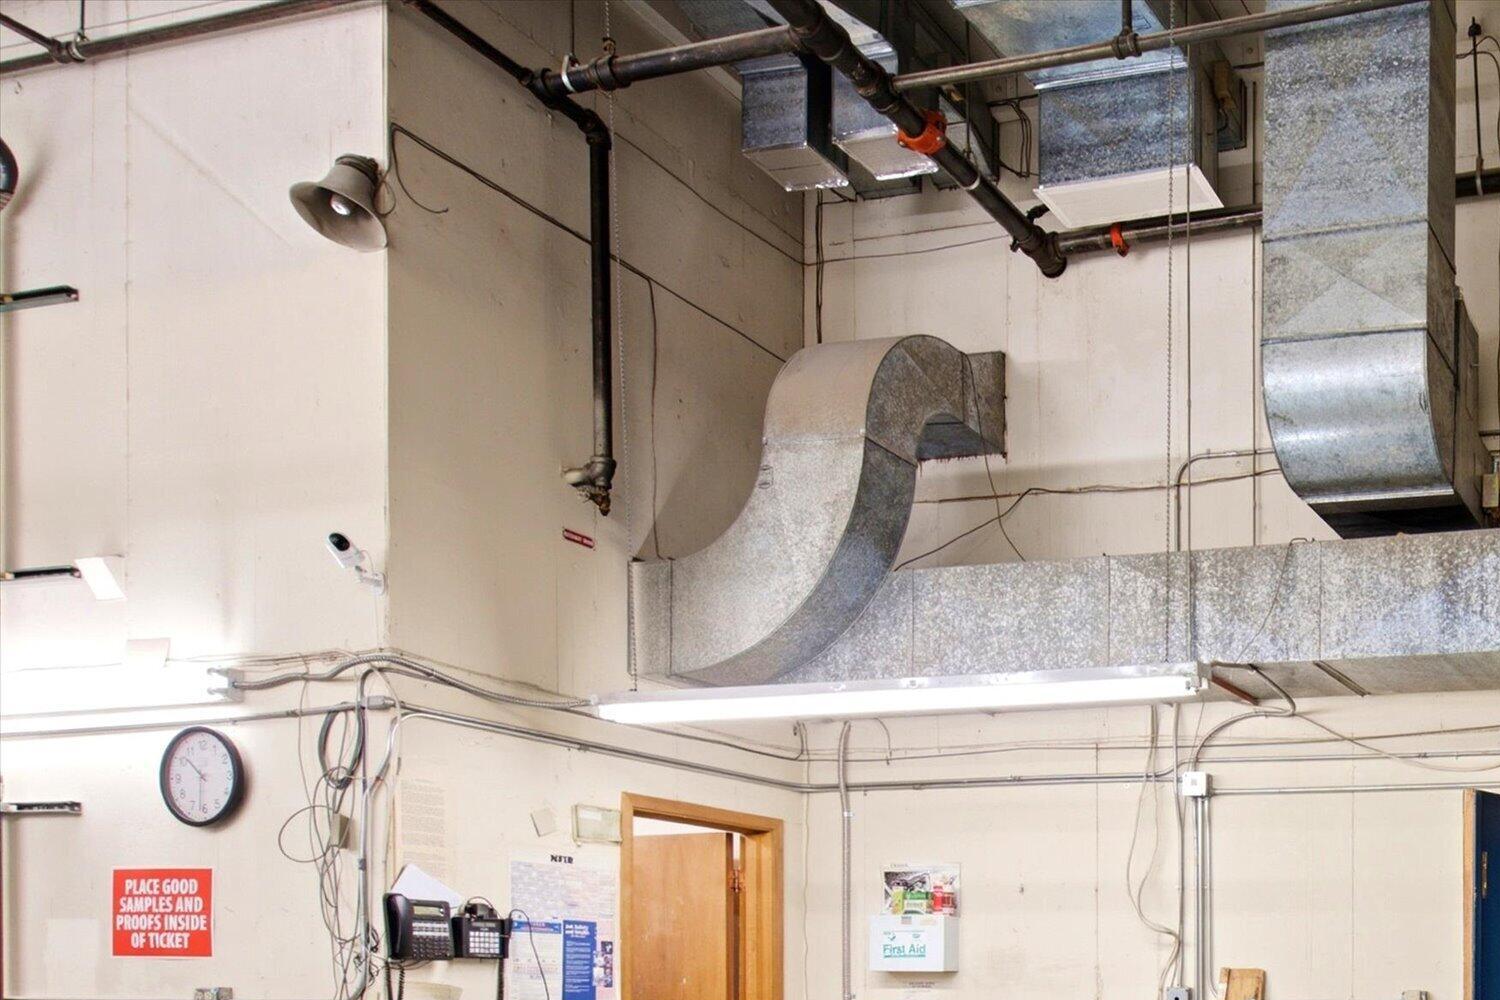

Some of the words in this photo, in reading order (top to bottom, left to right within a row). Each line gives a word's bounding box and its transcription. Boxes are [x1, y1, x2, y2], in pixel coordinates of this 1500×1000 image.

[125, 879, 160, 895] PLACE
[162, 879, 198, 895] GOOD
[120, 897, 173, 912] SAMPLES
[175, 897, 203, 912] AND
[116, 914, 162, 930] PROOFS
[164, 914, 207, 930] INSIDE
[131, 932, 146, 948] OF
[147, 932, 190, 948] TICKET
[883, 944, 905, 955] First
[909, 943, 926, 954] Aid
